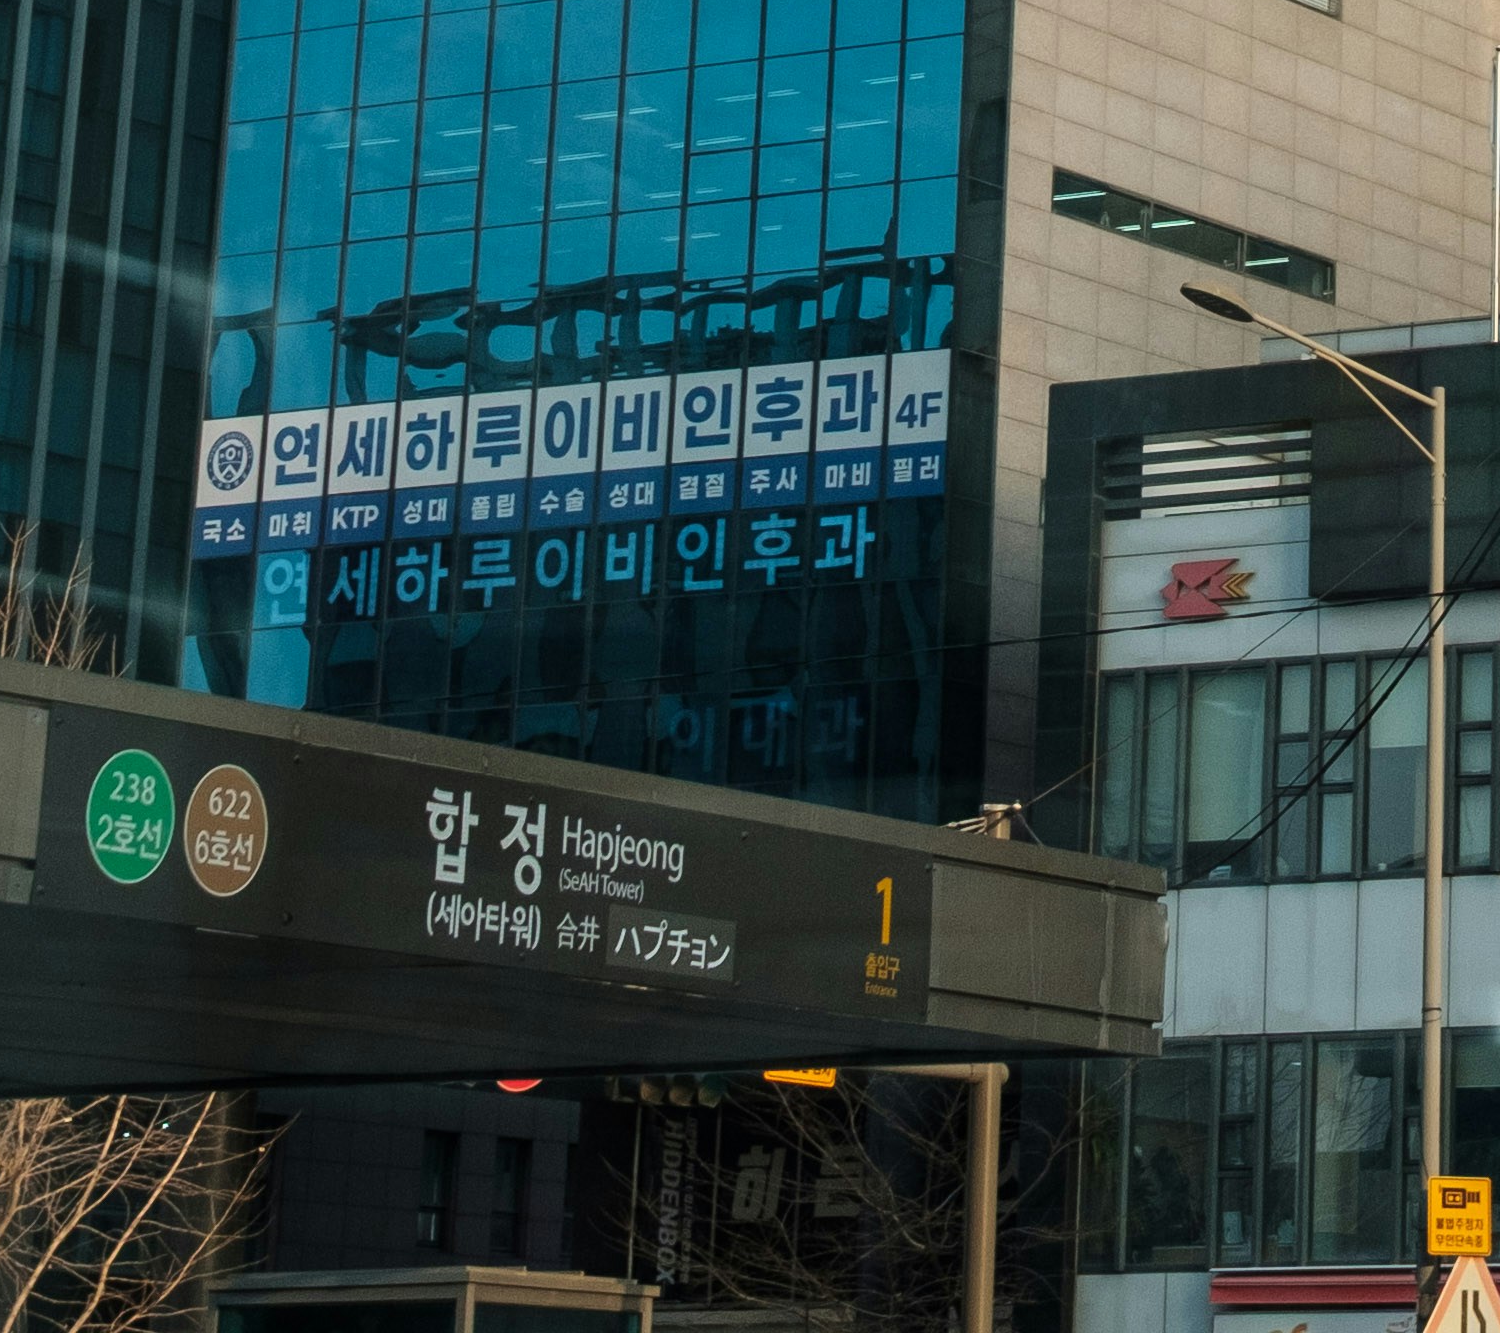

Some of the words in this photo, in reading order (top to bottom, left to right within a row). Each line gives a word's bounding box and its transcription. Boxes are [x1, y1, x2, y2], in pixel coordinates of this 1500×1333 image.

[273, 369, 878, 487] 연세하루이비인후과
[896, 391, 943, 429] 4F
[203, 518, 246, 543] 국소
[268, 511, 312, 538] 마취
[332, 505, 380, 530] KTP
[403, 497, 449, 525] 성대
[539, 486, 586, 516] 수술
[609, 481, 655, 509] 성대
[750, 466, 798, 494] 주사
[825, 461, 872, 489] 마비
[893, 455, 941, 483] 필러
[264, 505, 876, 625] 연세하루이비인후과
[110, 771, 156, 806] 238
[209, 787, 252, 820] 622
[96, 814, 163, 860] 2호선
[195, 830, 254, 872] 6호선
[562, 815, 685, 883] Hapjeong
[559, 868, 600, 894] (SeAH
[602, 874, 644, 904] Tower)
[426, 891, 541, 950] (세아타워)
[556, 913, 600, 952] 合井
[876, 877, 892, 945] 1
[614, 920, 731, 970] ハプチョン
[865, 952, 900, 980] 출입구
